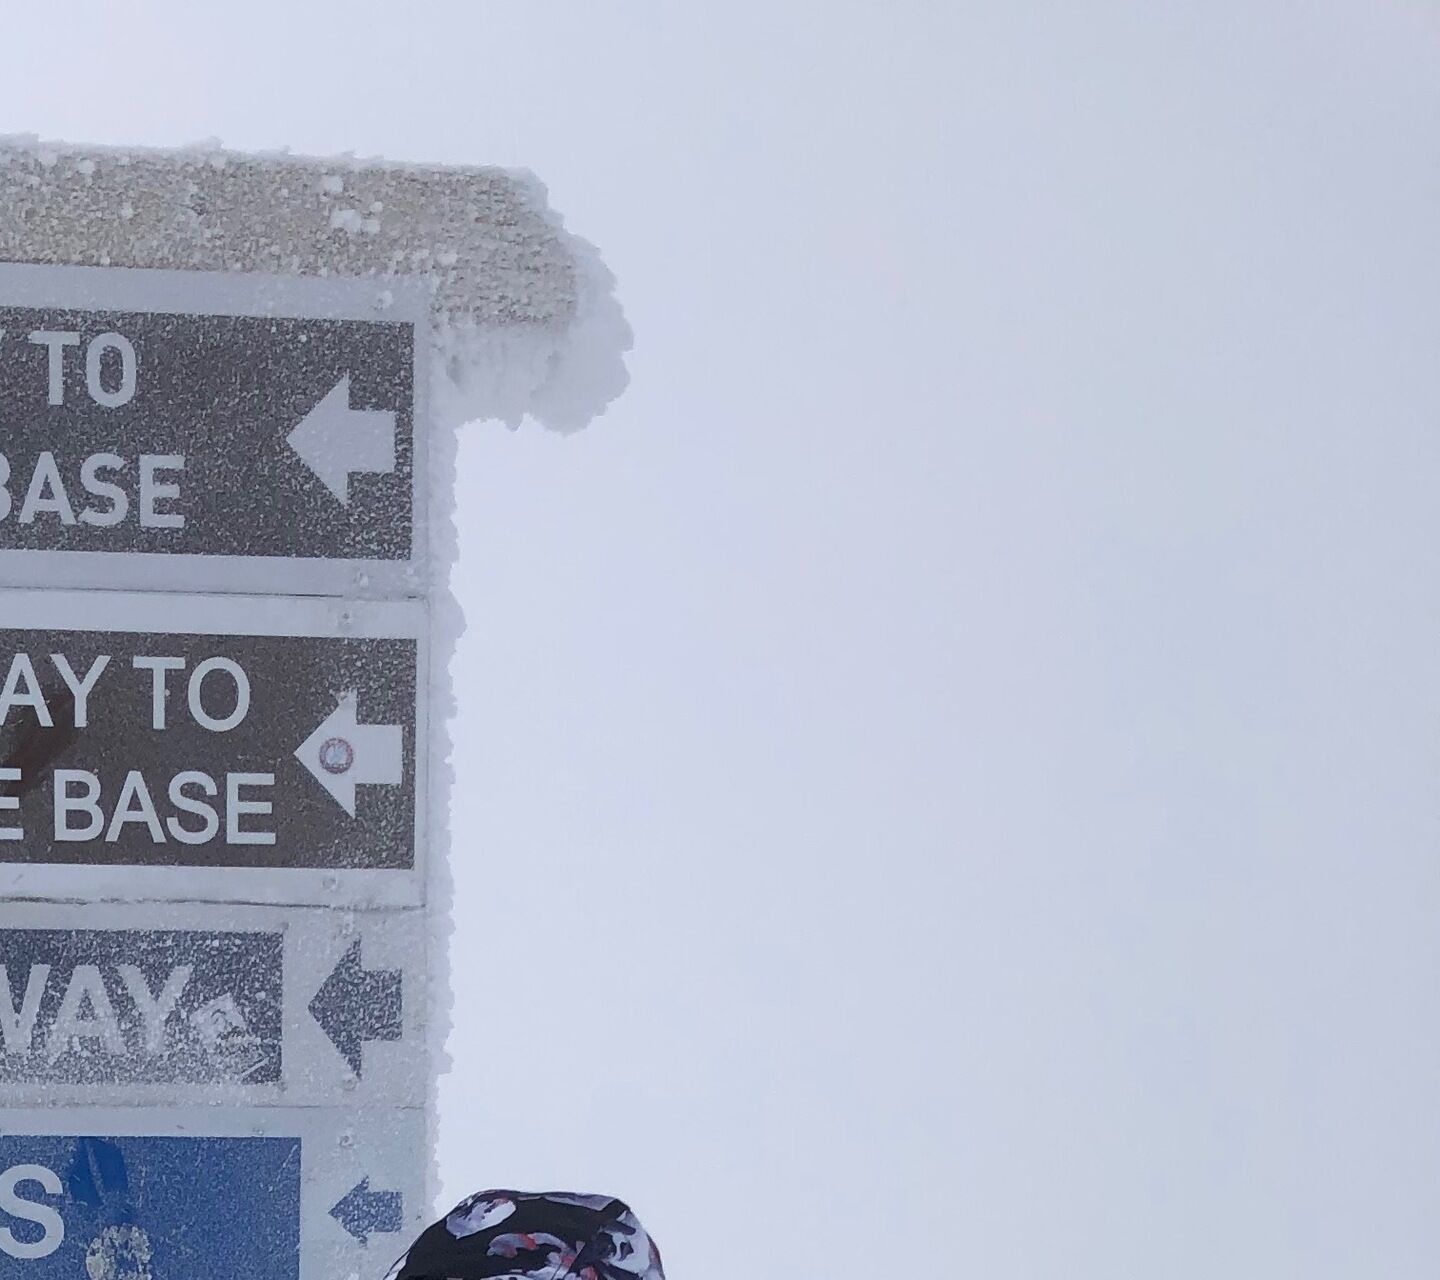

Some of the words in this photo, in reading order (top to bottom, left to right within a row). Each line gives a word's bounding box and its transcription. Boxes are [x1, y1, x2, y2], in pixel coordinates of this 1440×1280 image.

[29, 330, 137, 409] TO
[132, 655, 251, 734] TO
[54, 768, 278, 847] BASE
